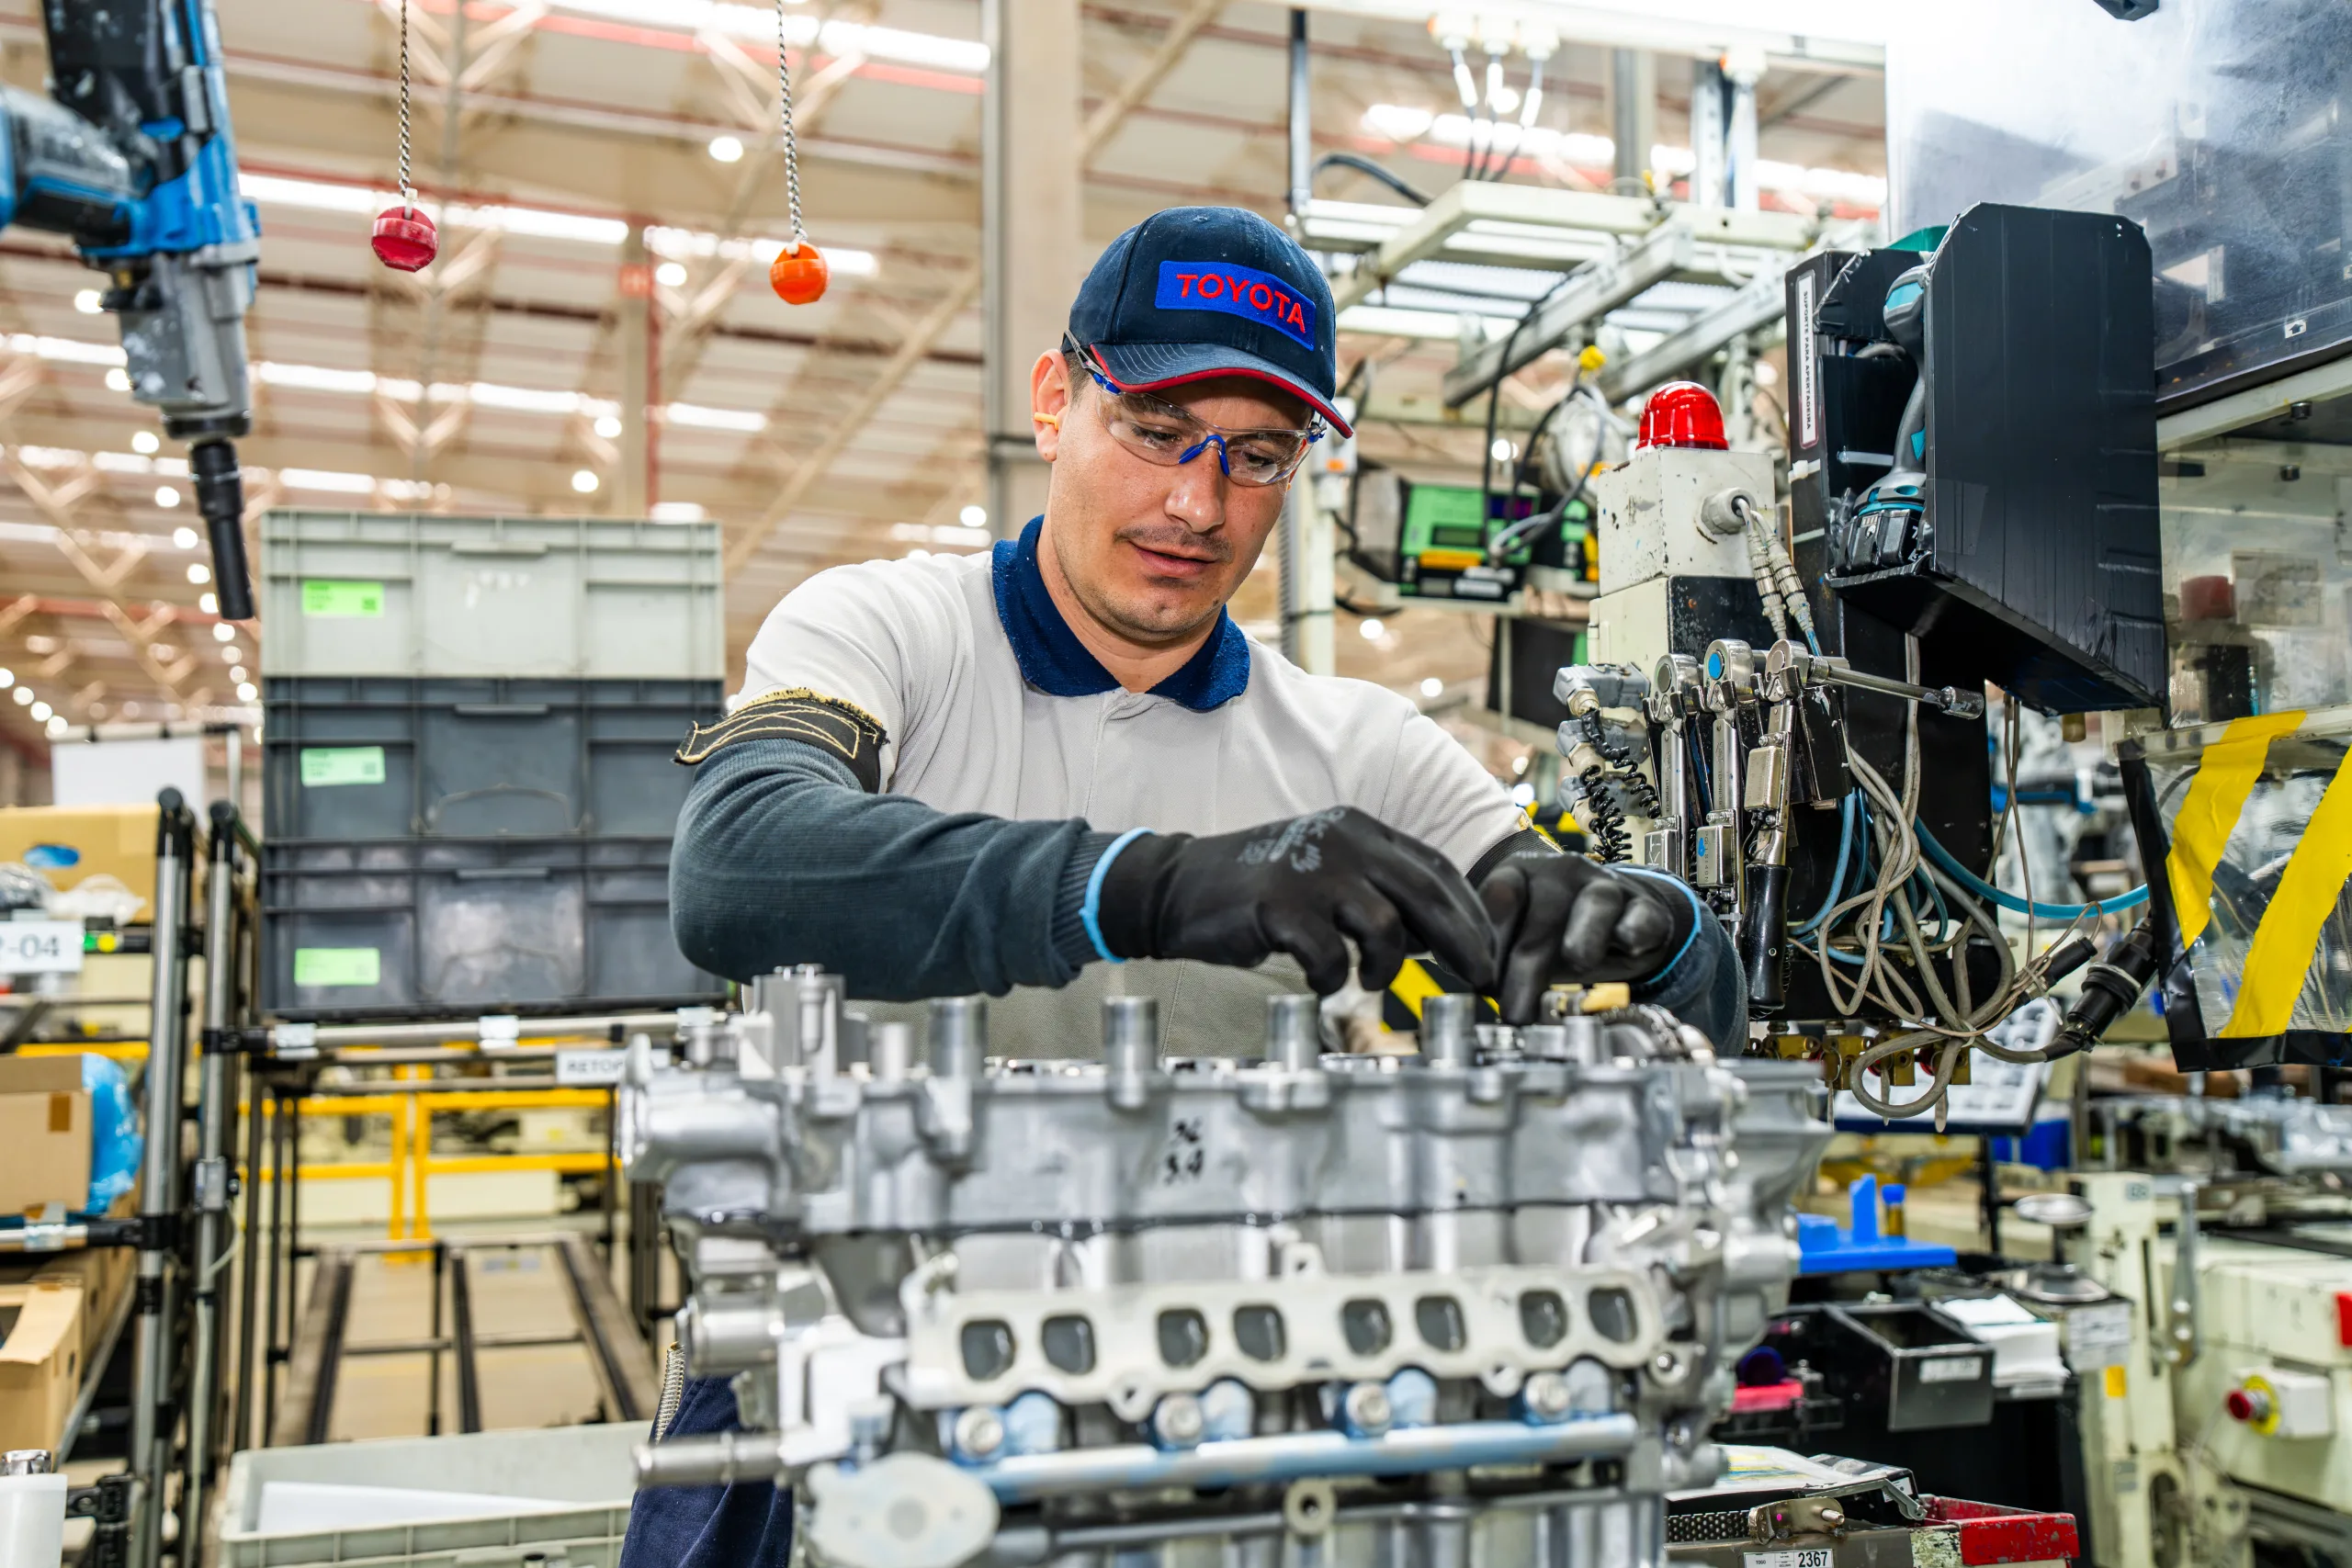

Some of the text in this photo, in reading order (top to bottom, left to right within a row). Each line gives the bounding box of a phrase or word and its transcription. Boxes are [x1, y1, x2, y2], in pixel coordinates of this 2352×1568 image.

[1177, 274, 1306, 333] TOYOTA
[0, 933, 61, 960] -04
[1798, 1551, 1827, 1567] 2367
